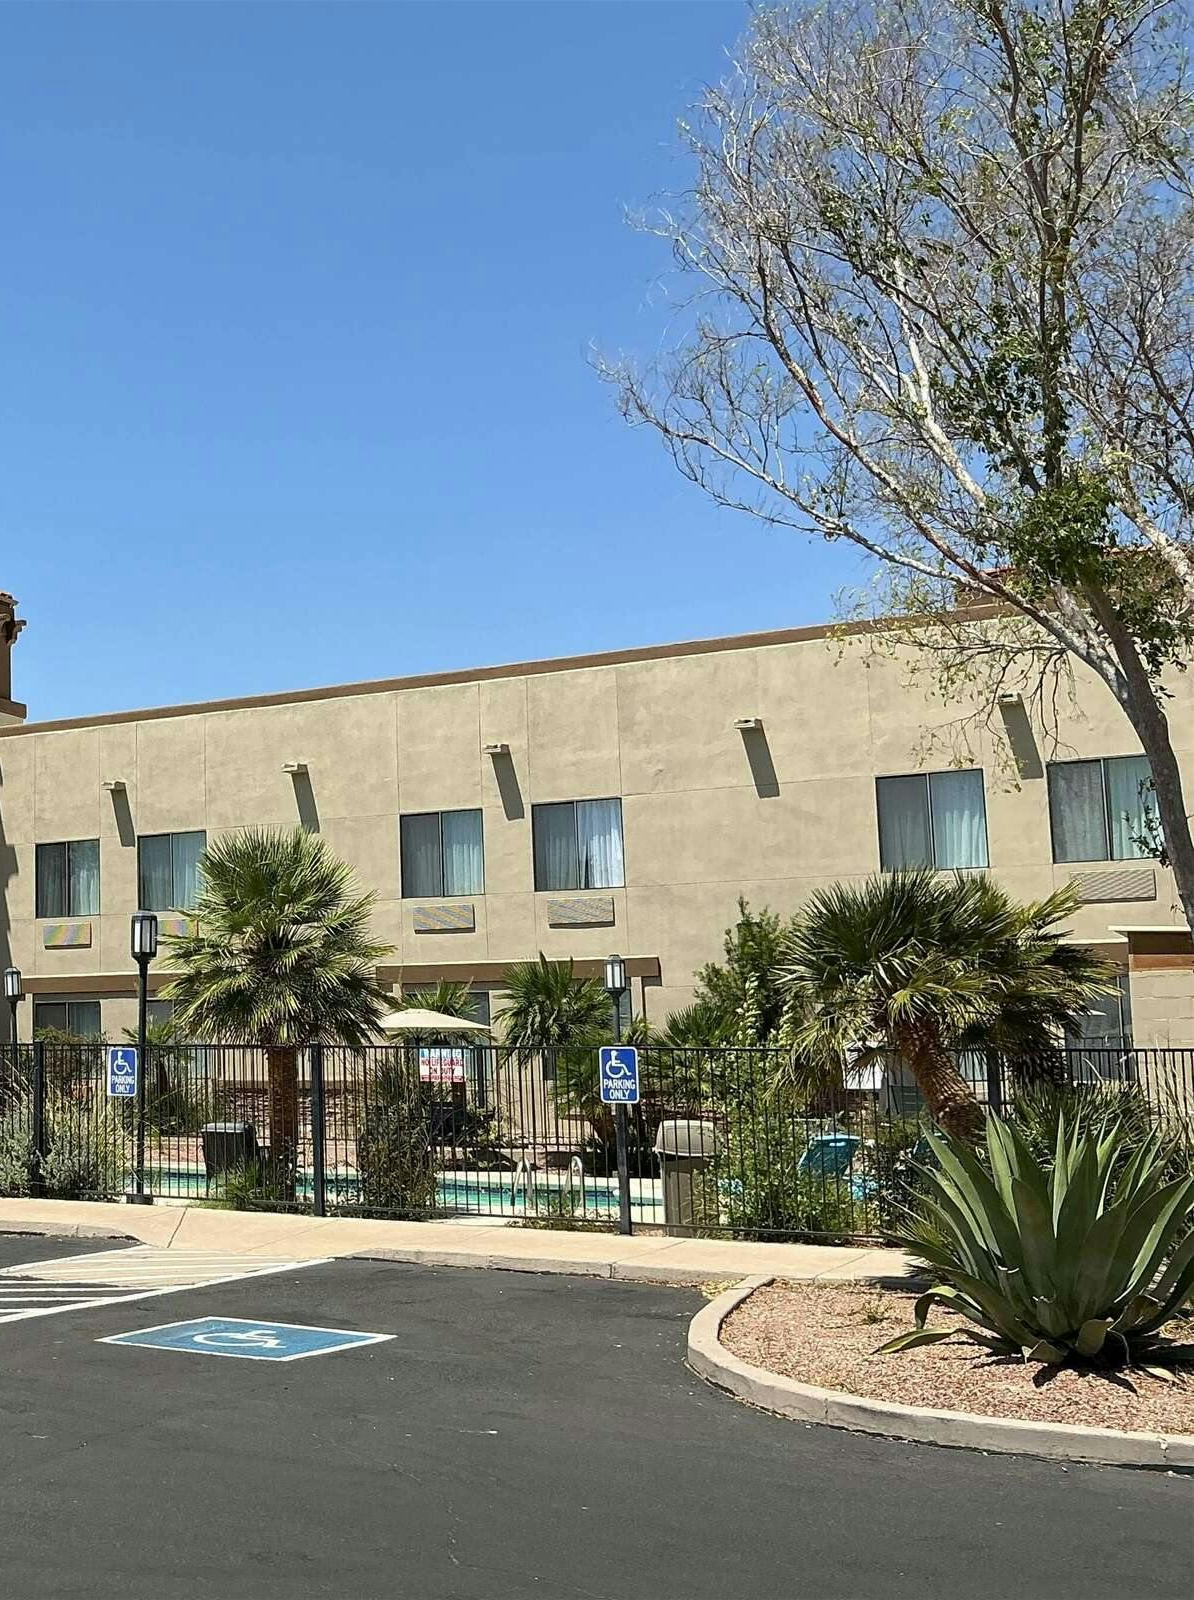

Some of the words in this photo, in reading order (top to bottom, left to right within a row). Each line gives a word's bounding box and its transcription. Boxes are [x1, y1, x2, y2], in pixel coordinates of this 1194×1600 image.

[423, 1049, 462, 1058] WARNIG
[111, 1075, 134, 1084] PARKING
[603, 1079, 635, 1089] PARKING
[116, 1084, 130, 1093] ONLY
[609, 1090, 629, 1099] ONLY
